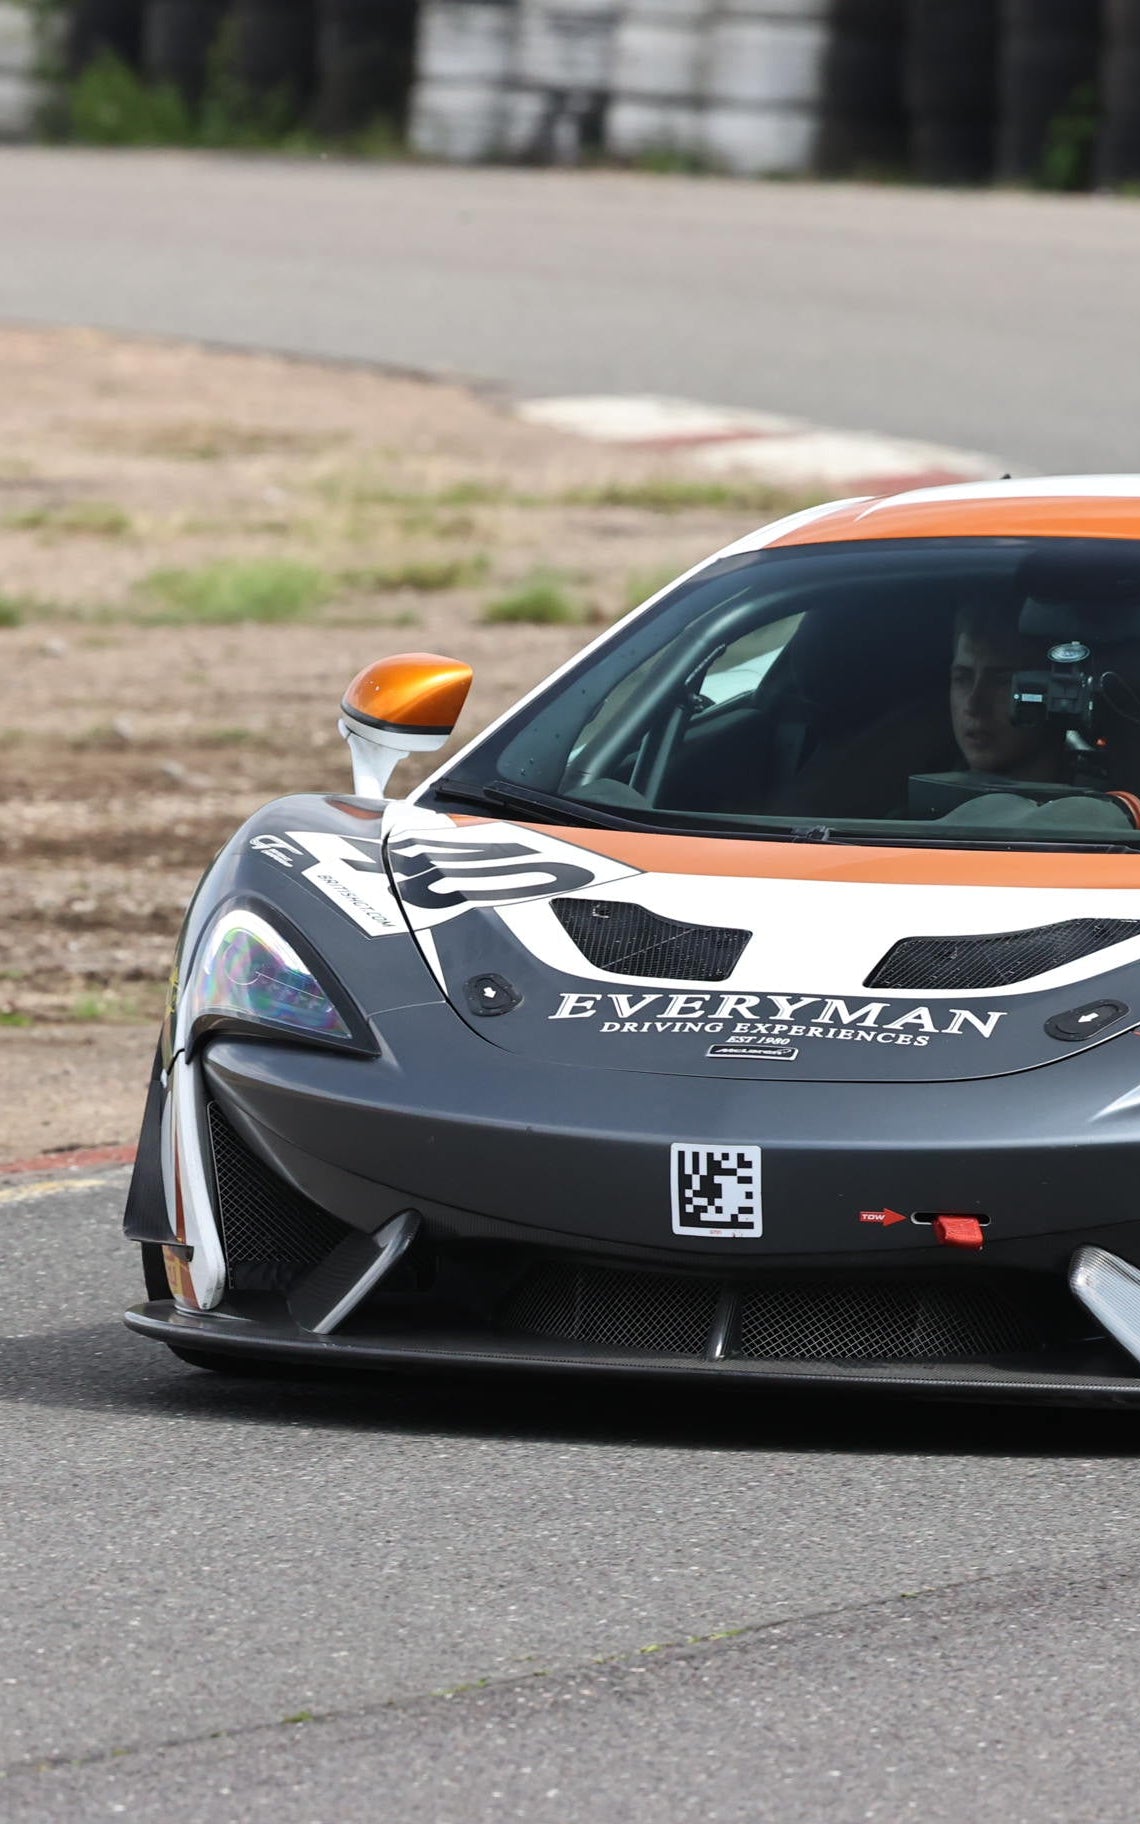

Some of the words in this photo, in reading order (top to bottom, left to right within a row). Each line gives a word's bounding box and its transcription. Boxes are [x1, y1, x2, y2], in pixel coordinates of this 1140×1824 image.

[547, 992, 1008, 1039] EVERYMAN
[599, 1021, 724, 1033] DRIVING
[732, 1022, 930, 1047] EXPERIENCES
[725, 1035, 757, 1044] EST
[757, 1036, 791, 1046] 1980
[861, 1213, 886, 1221] TOW
